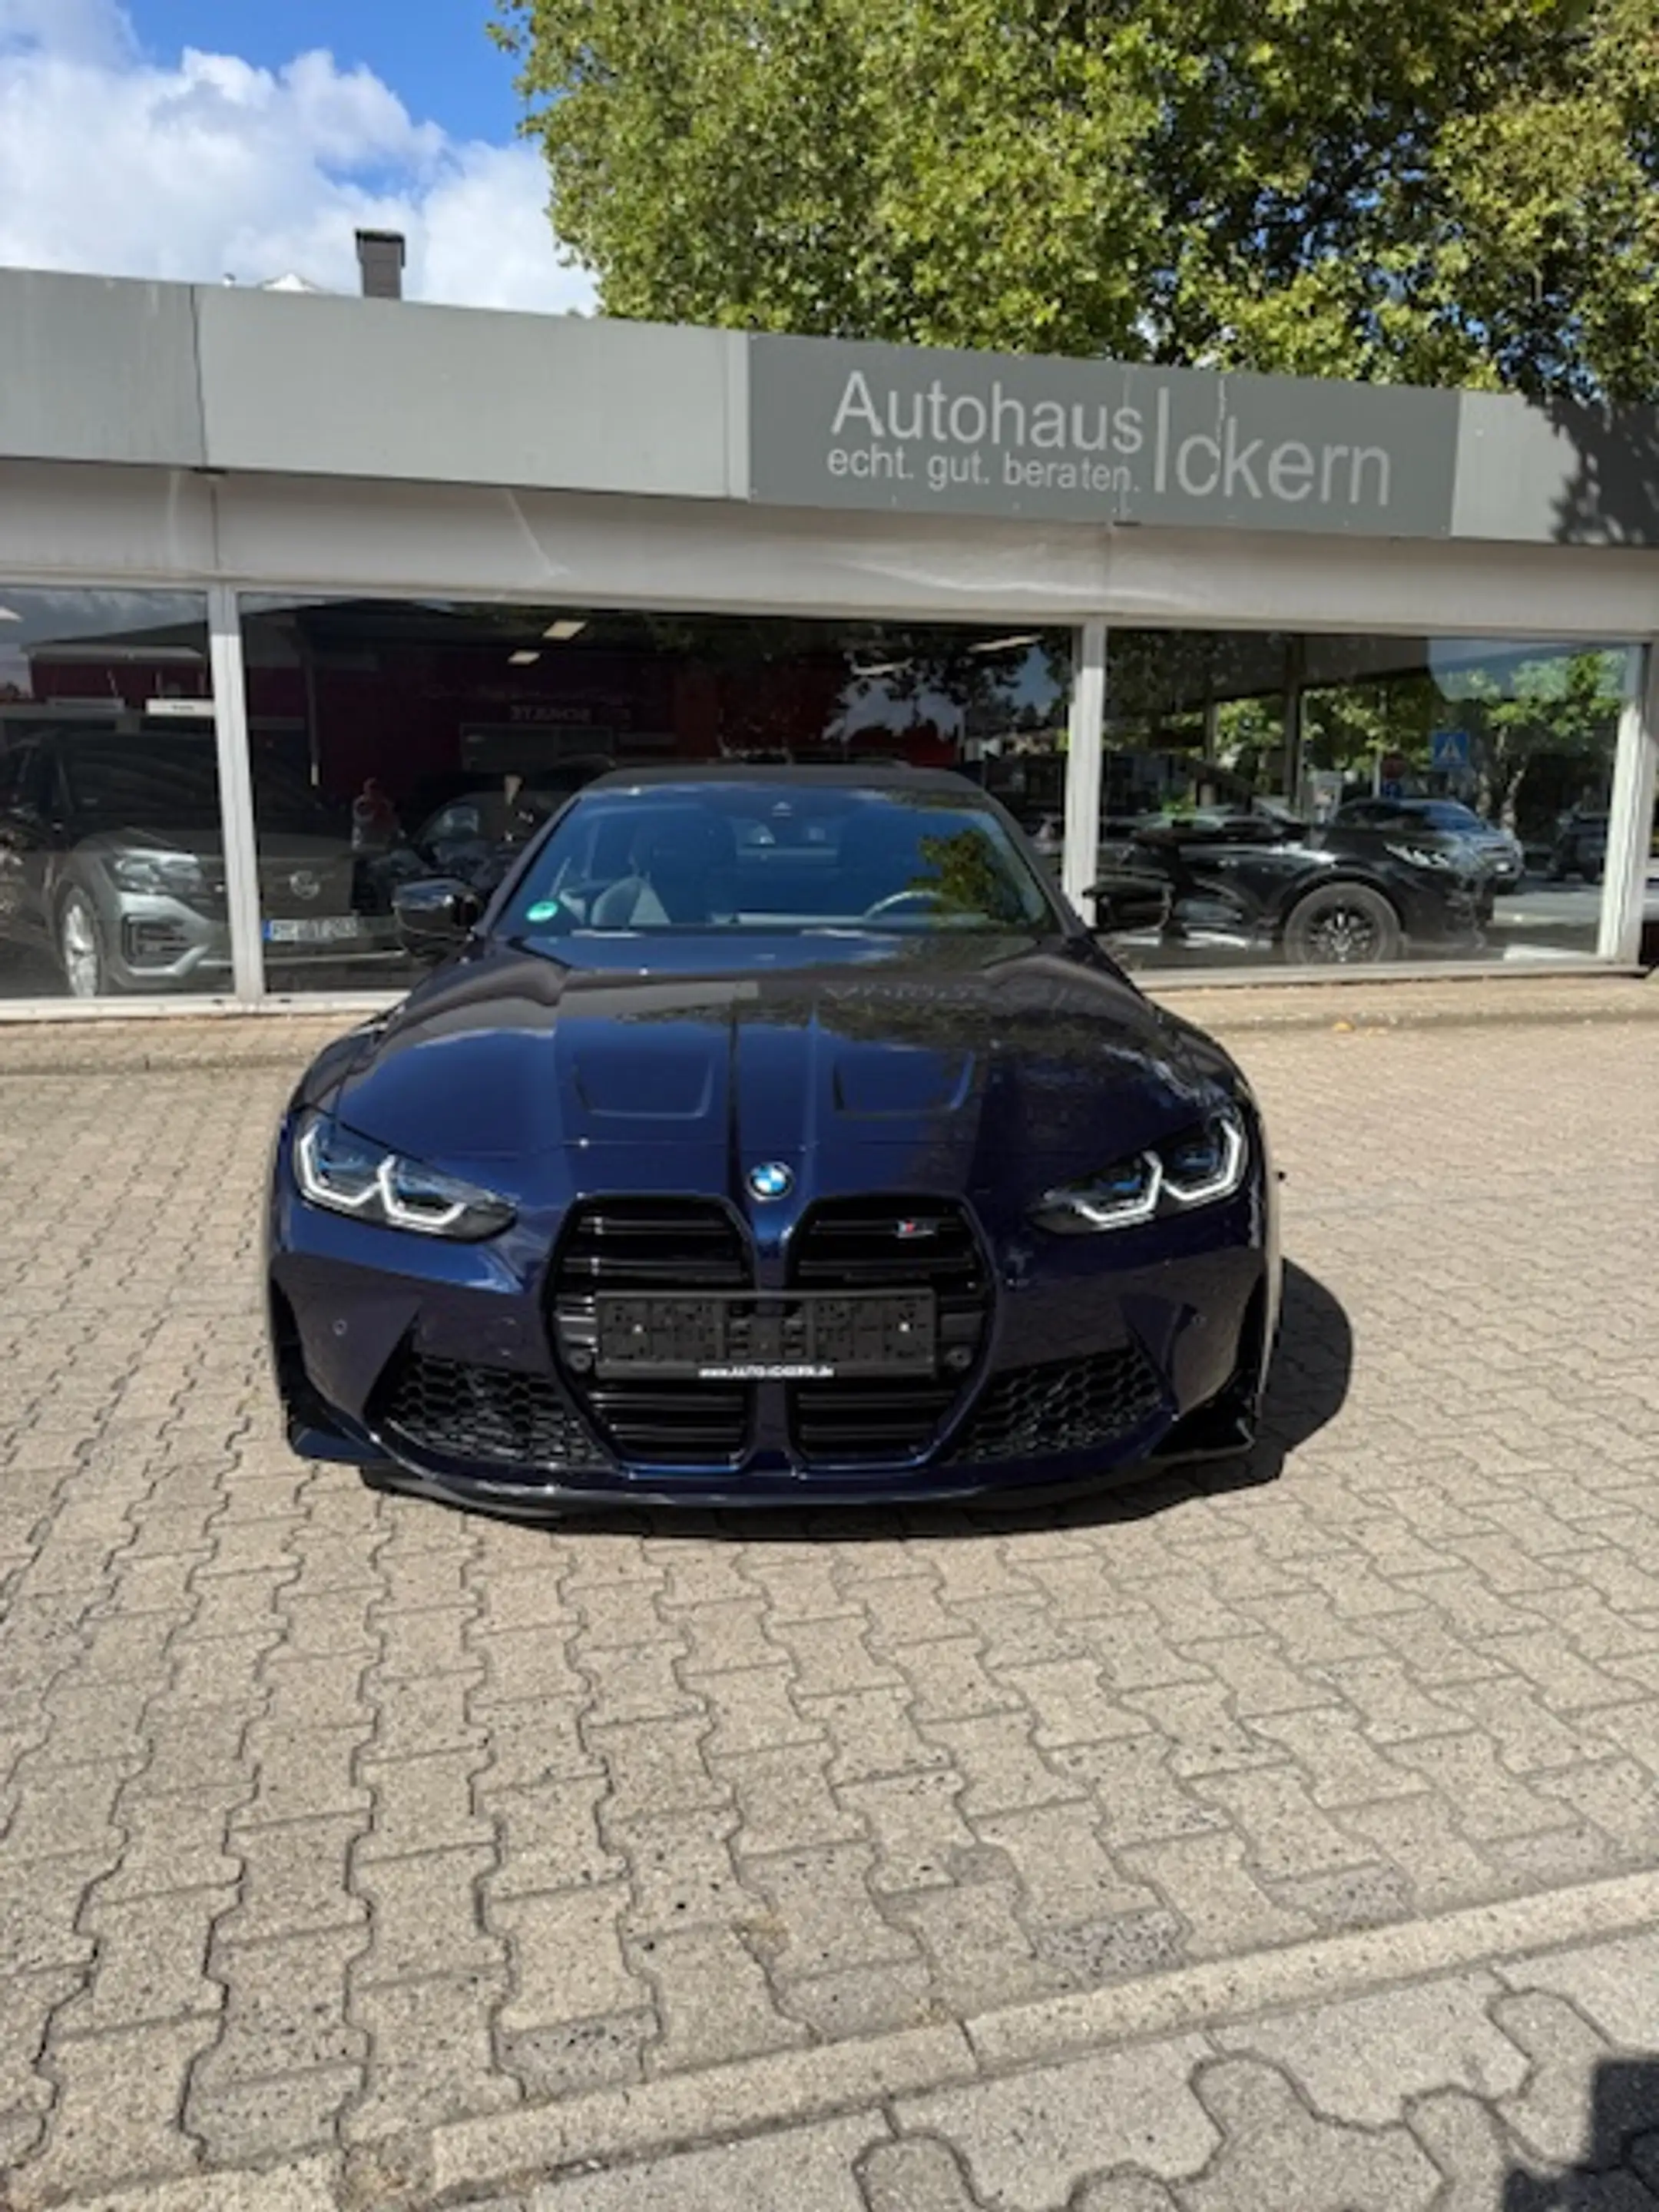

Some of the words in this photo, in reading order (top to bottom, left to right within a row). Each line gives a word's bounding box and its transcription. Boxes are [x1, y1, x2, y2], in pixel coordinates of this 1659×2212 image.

[827, 443, 914, 480] echt.
[927, 450, 990, 492] gut.
[1003, 451, 1141, 492] beraten.
[830, 370, 1143, 453] Autohaus
[1154, 386, 1391, 506] Ickern
